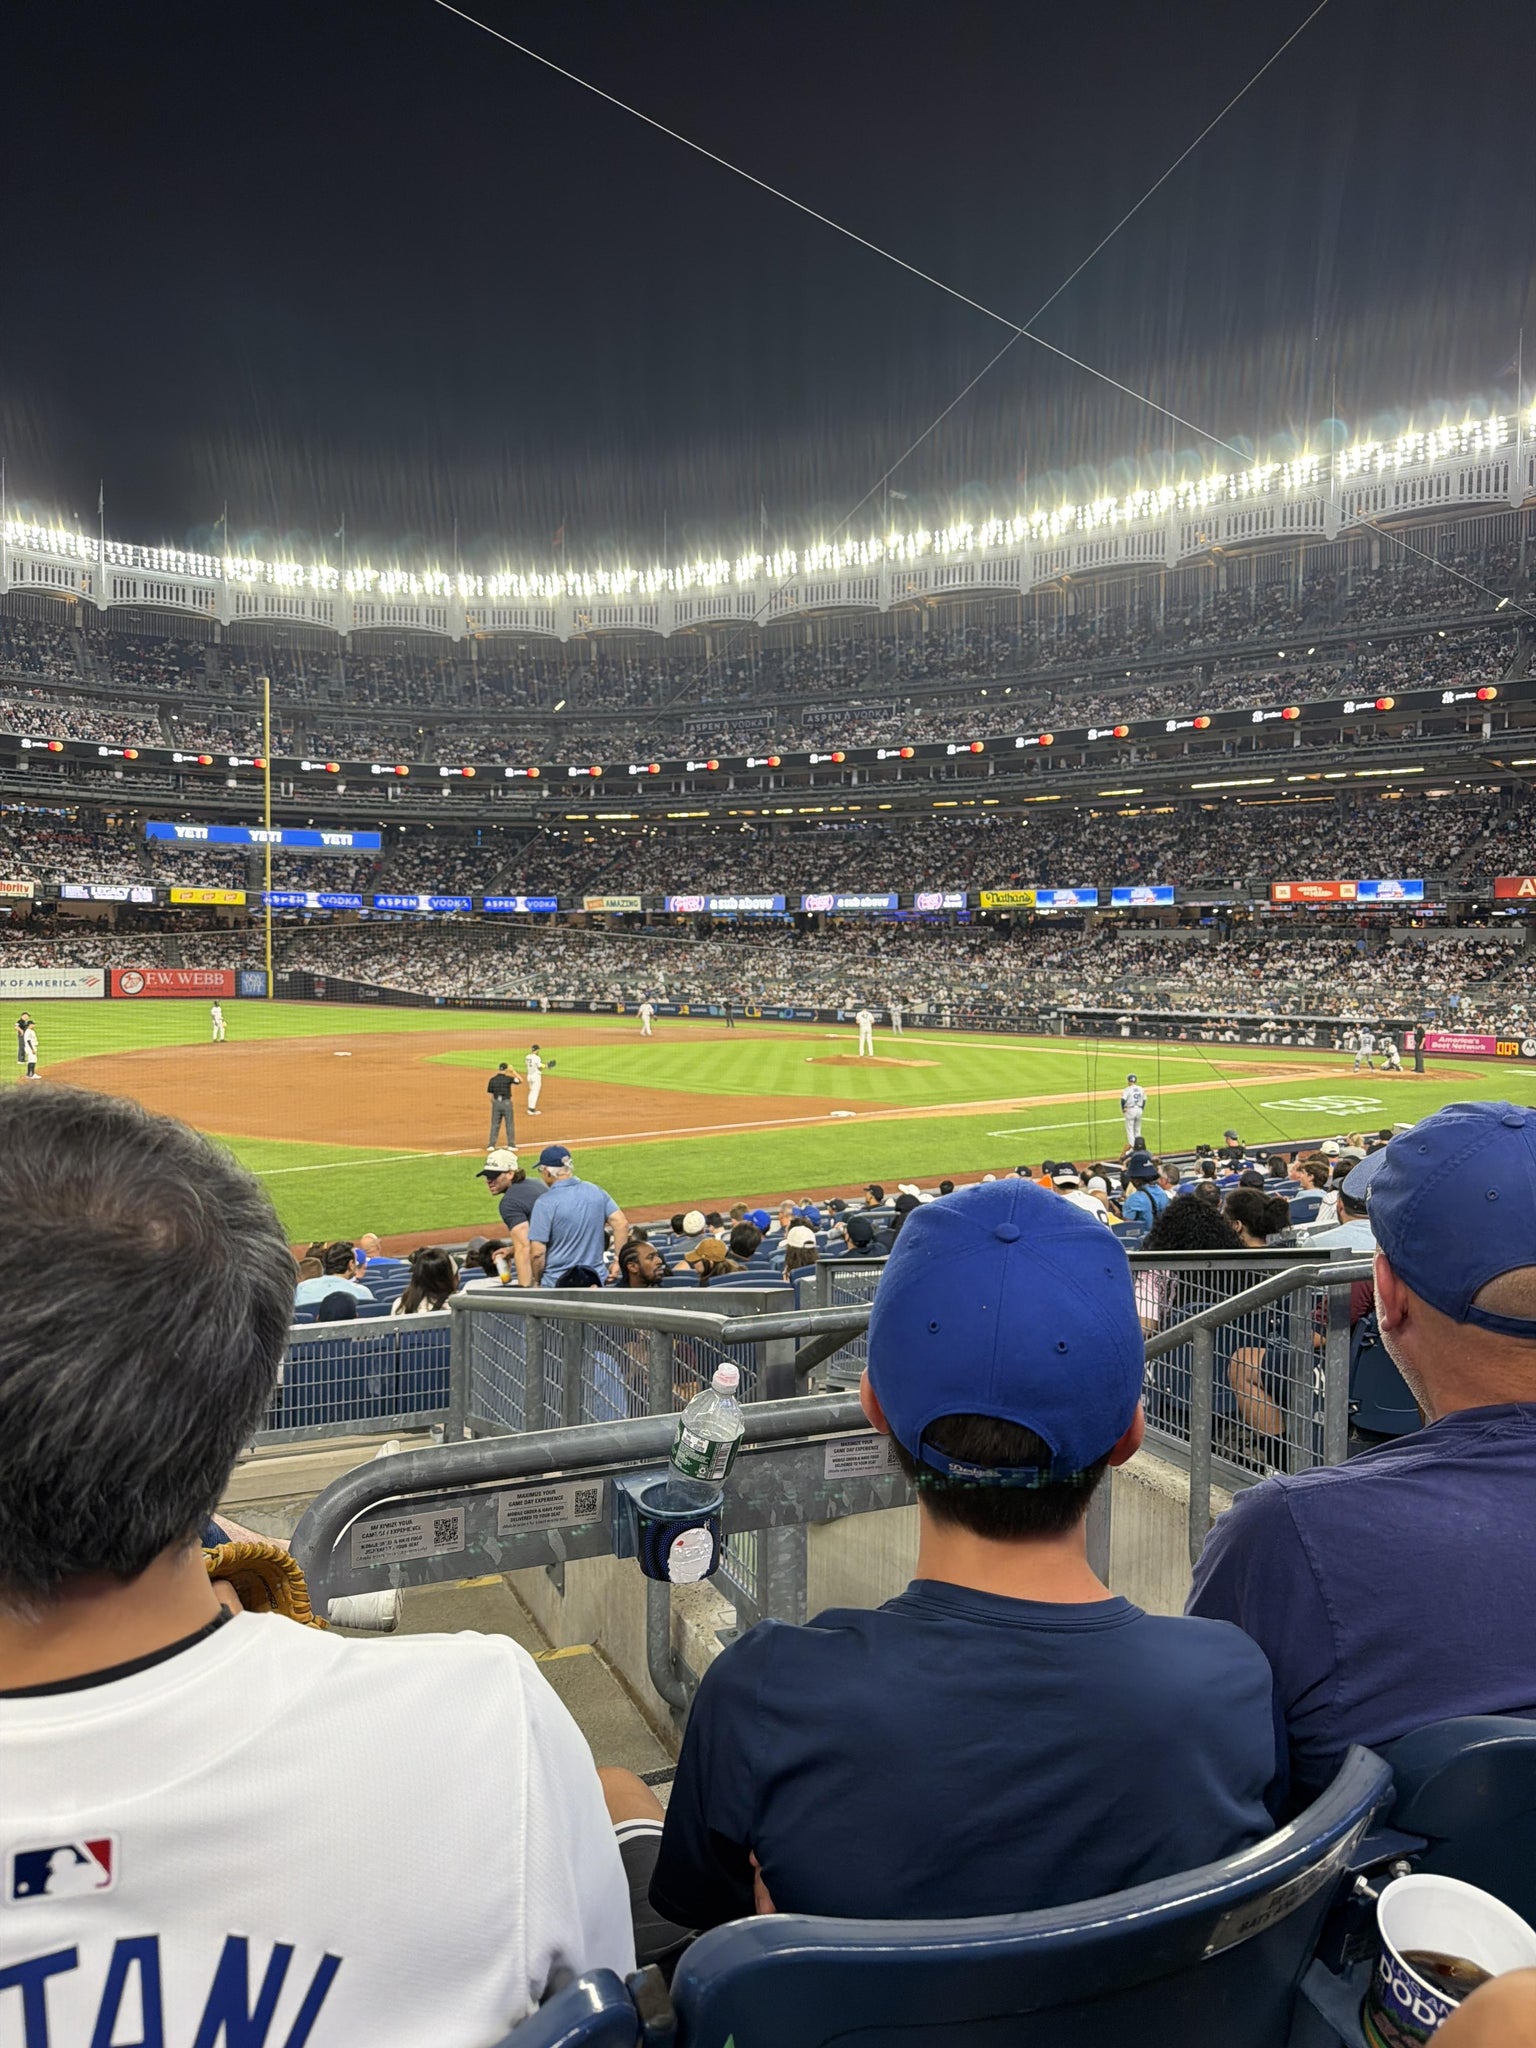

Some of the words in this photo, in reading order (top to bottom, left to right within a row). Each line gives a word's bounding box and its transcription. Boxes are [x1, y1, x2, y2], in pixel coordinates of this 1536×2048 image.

[807, 713, 840, 722] ASPEN
[854, 709, 889, 719] VODKA
[174, 826, 208, 839] YETI
[249, 830, 282, 842] YETI
[321, 833, 352, 845] YETI
[1517, 878, 1536, 896] A
[320, 896, 360, 906] VODKA
[378, 898, 418, 906] ASPEN
[432, 898, 469, 908] VODKA
[146, 972, 173, 985] F.W.
[176, 972, 224, 985] WEBB
[1438, 1036, 1480, 1044] America's
[0, 1933, 343, 2048] TANI
[1380, 1954, 1446, 2028] DOD
[1391, 1958, 1421, 1997] LOS
[1425, 1997, 1450, 2018] AN
